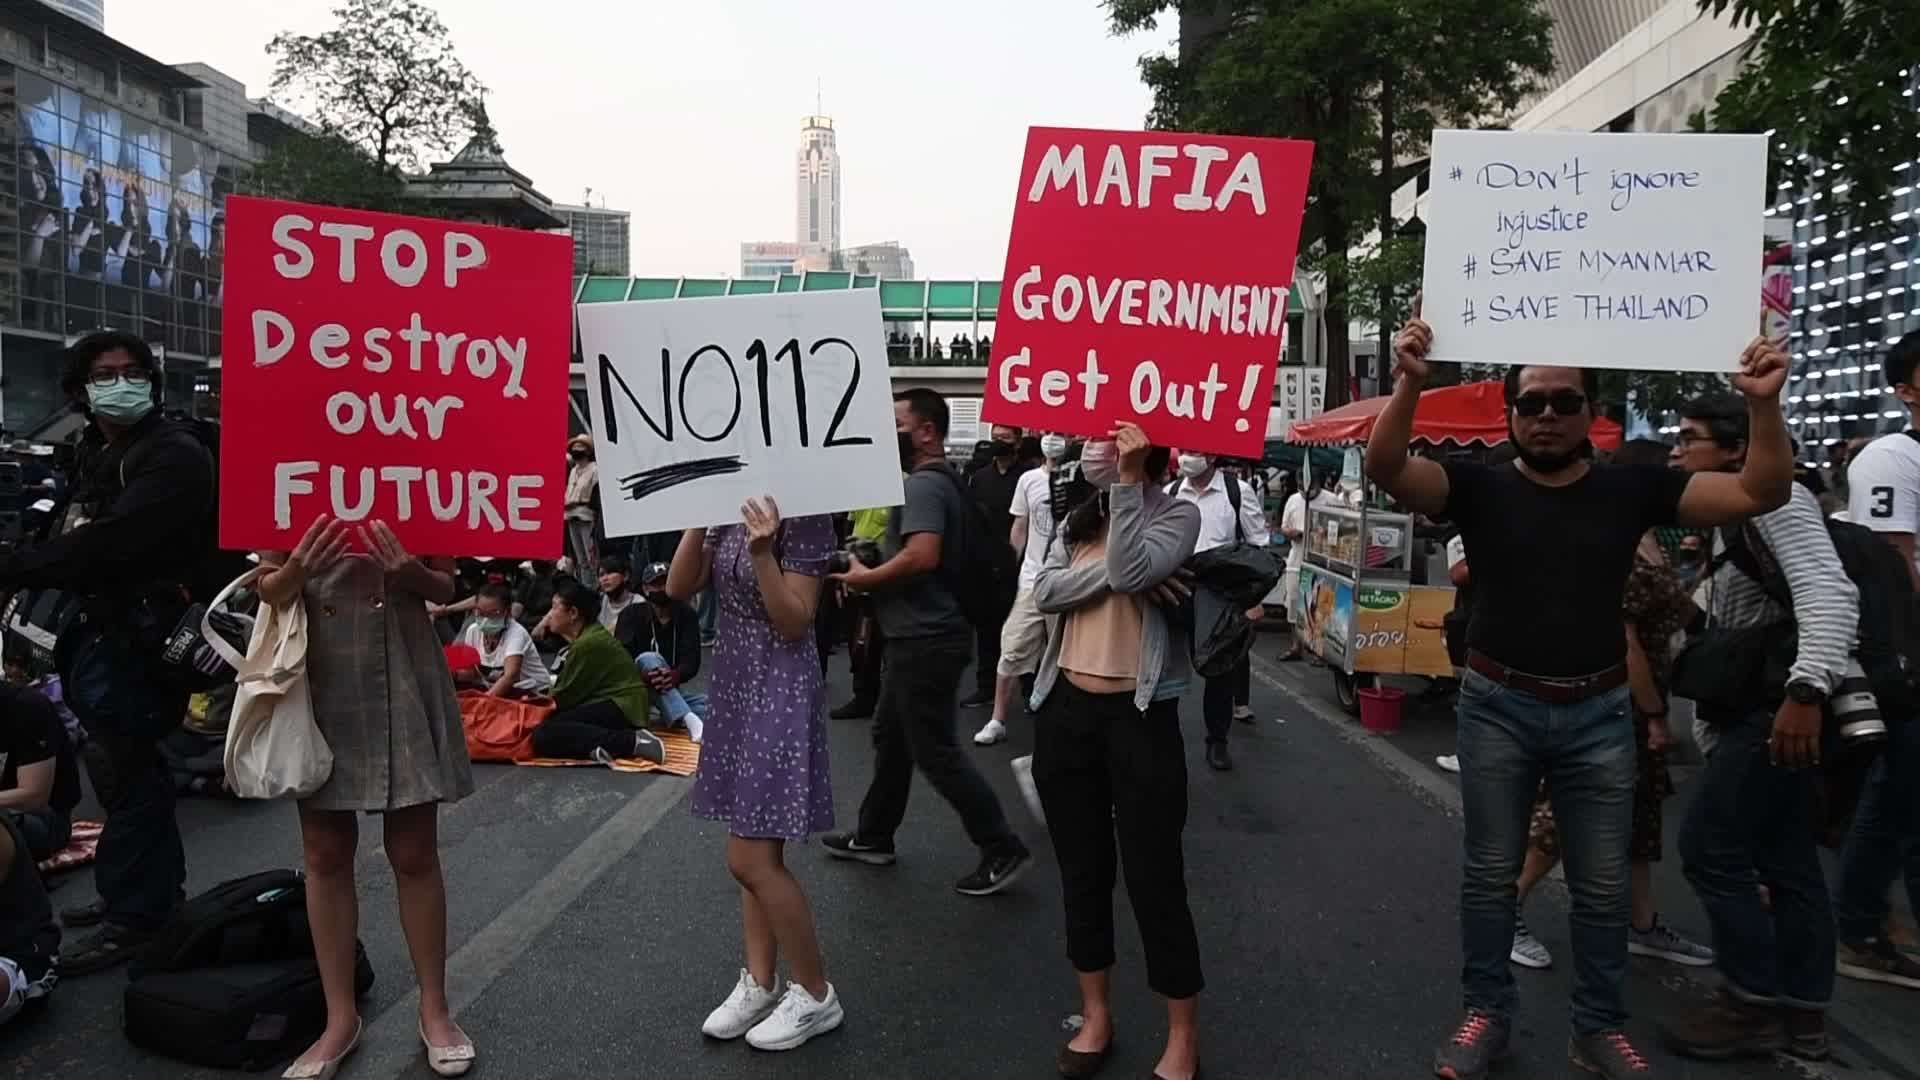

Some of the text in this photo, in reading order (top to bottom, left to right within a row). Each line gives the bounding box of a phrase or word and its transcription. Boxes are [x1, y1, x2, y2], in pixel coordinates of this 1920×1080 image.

[1027, 143, 1267, 216] MAFIA
[271, 214, 488, 290] STOP
[1489, 248, 1563, 277] SAVE
[1579, 250, 1717, 281] MYANMAR
[1013, 265, 1289, 338] GOVERNMENT
[1488, 294, 1560, 322] SAVE
[1573, 293, 1709, 321] THAILAND
[251, 309, 529, 400] Destroy
[999, 346, 1109, 411] Get
[1129, 360, 1264, 433] Out!
[325, 391, 465, 441] our
[274, 460, 546, 533] FUTURE
[1870, 486, 1895, 519] 3
[167, 630, 195, 661] PRESS
